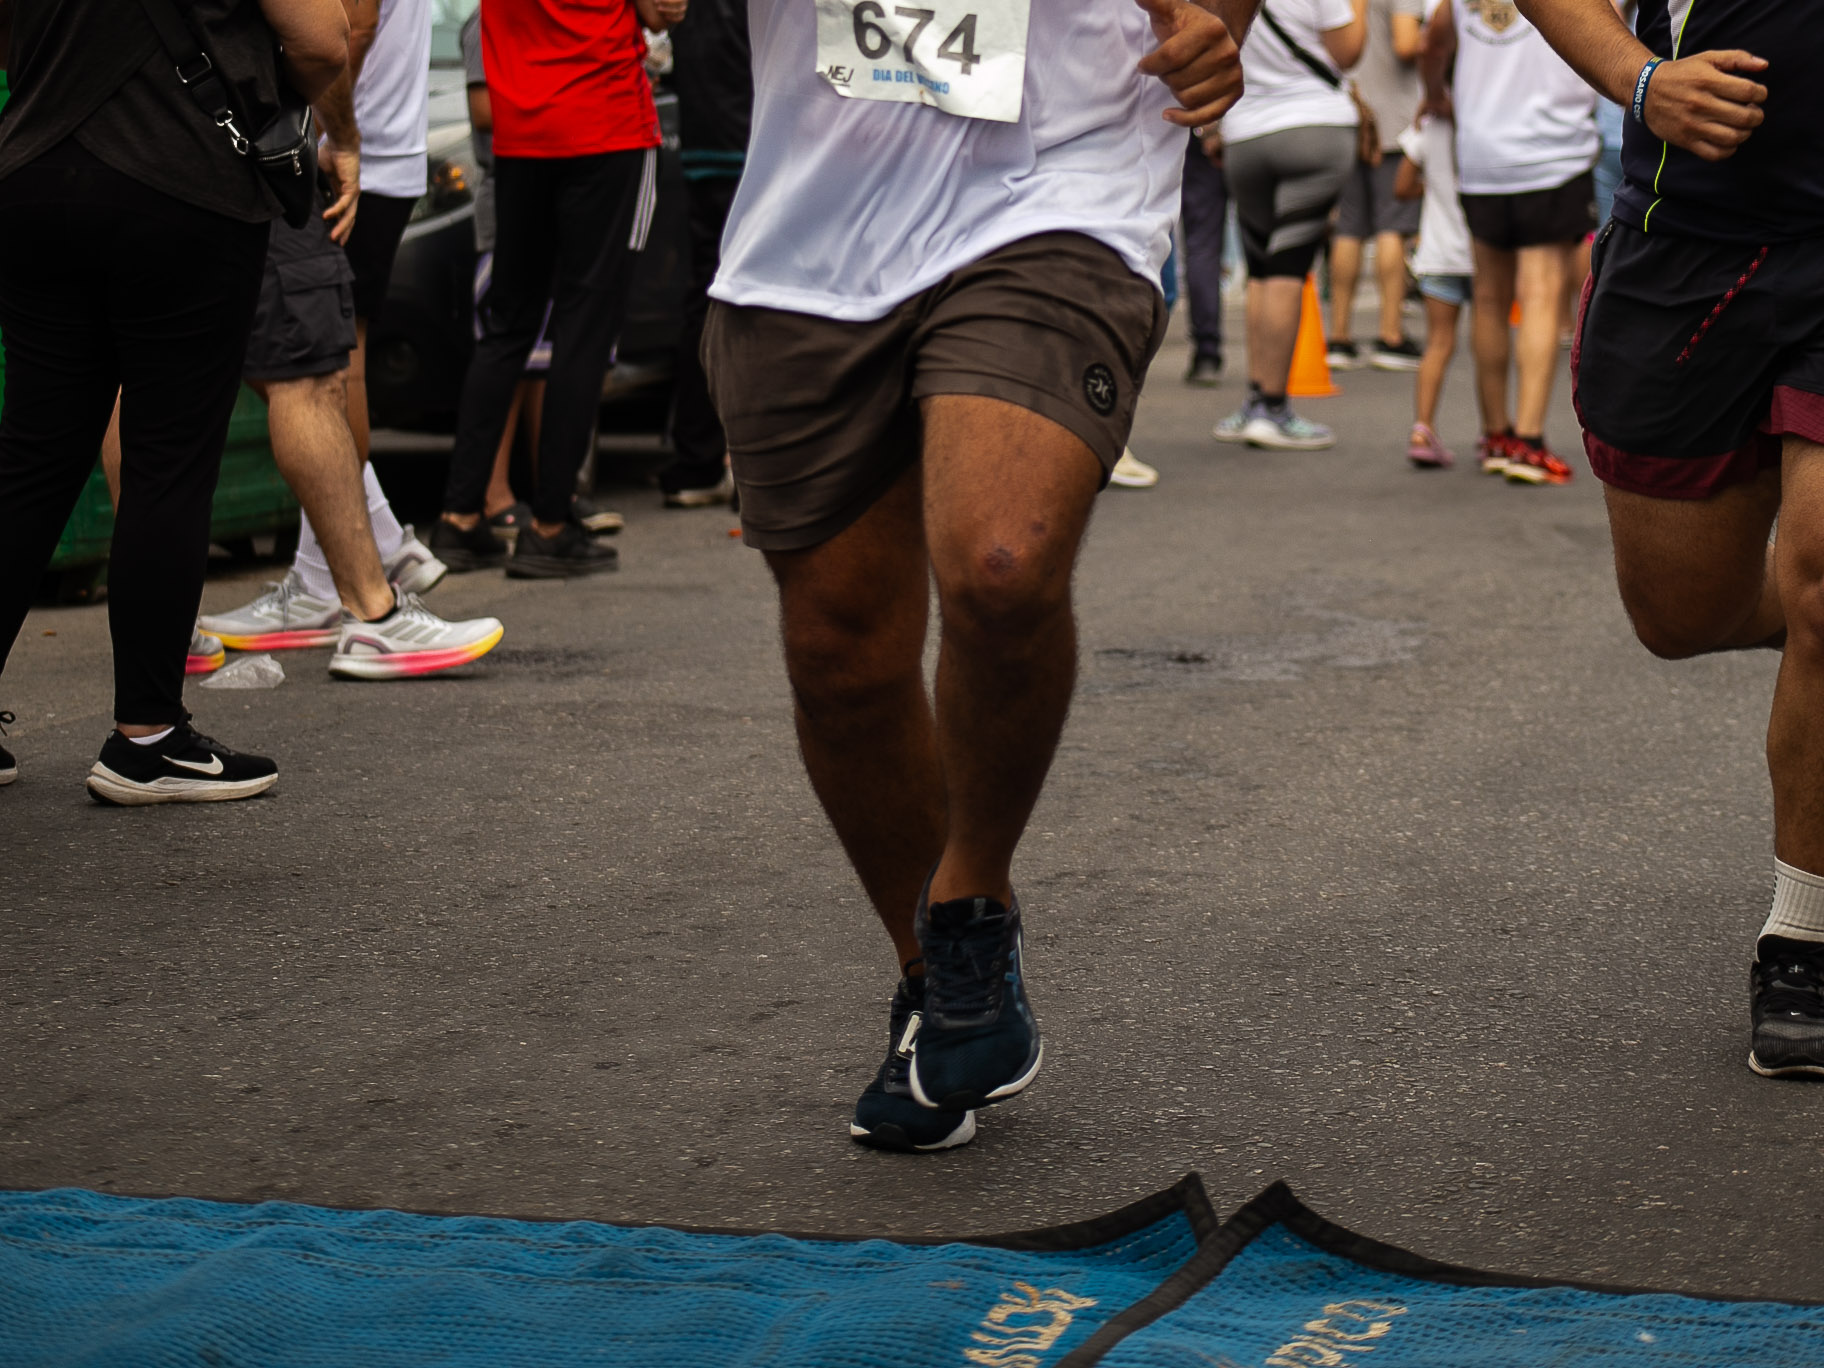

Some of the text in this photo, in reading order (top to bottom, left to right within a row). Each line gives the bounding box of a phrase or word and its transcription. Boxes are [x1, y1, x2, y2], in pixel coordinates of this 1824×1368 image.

[853, 0, 981, 76] 674
[826, 65, 854, 84] NEJ
[872, 68, 892, 82] DIA
[895, 70, 915, 83] DEL
[1634, 65, 1652, 103] ROSARIO
